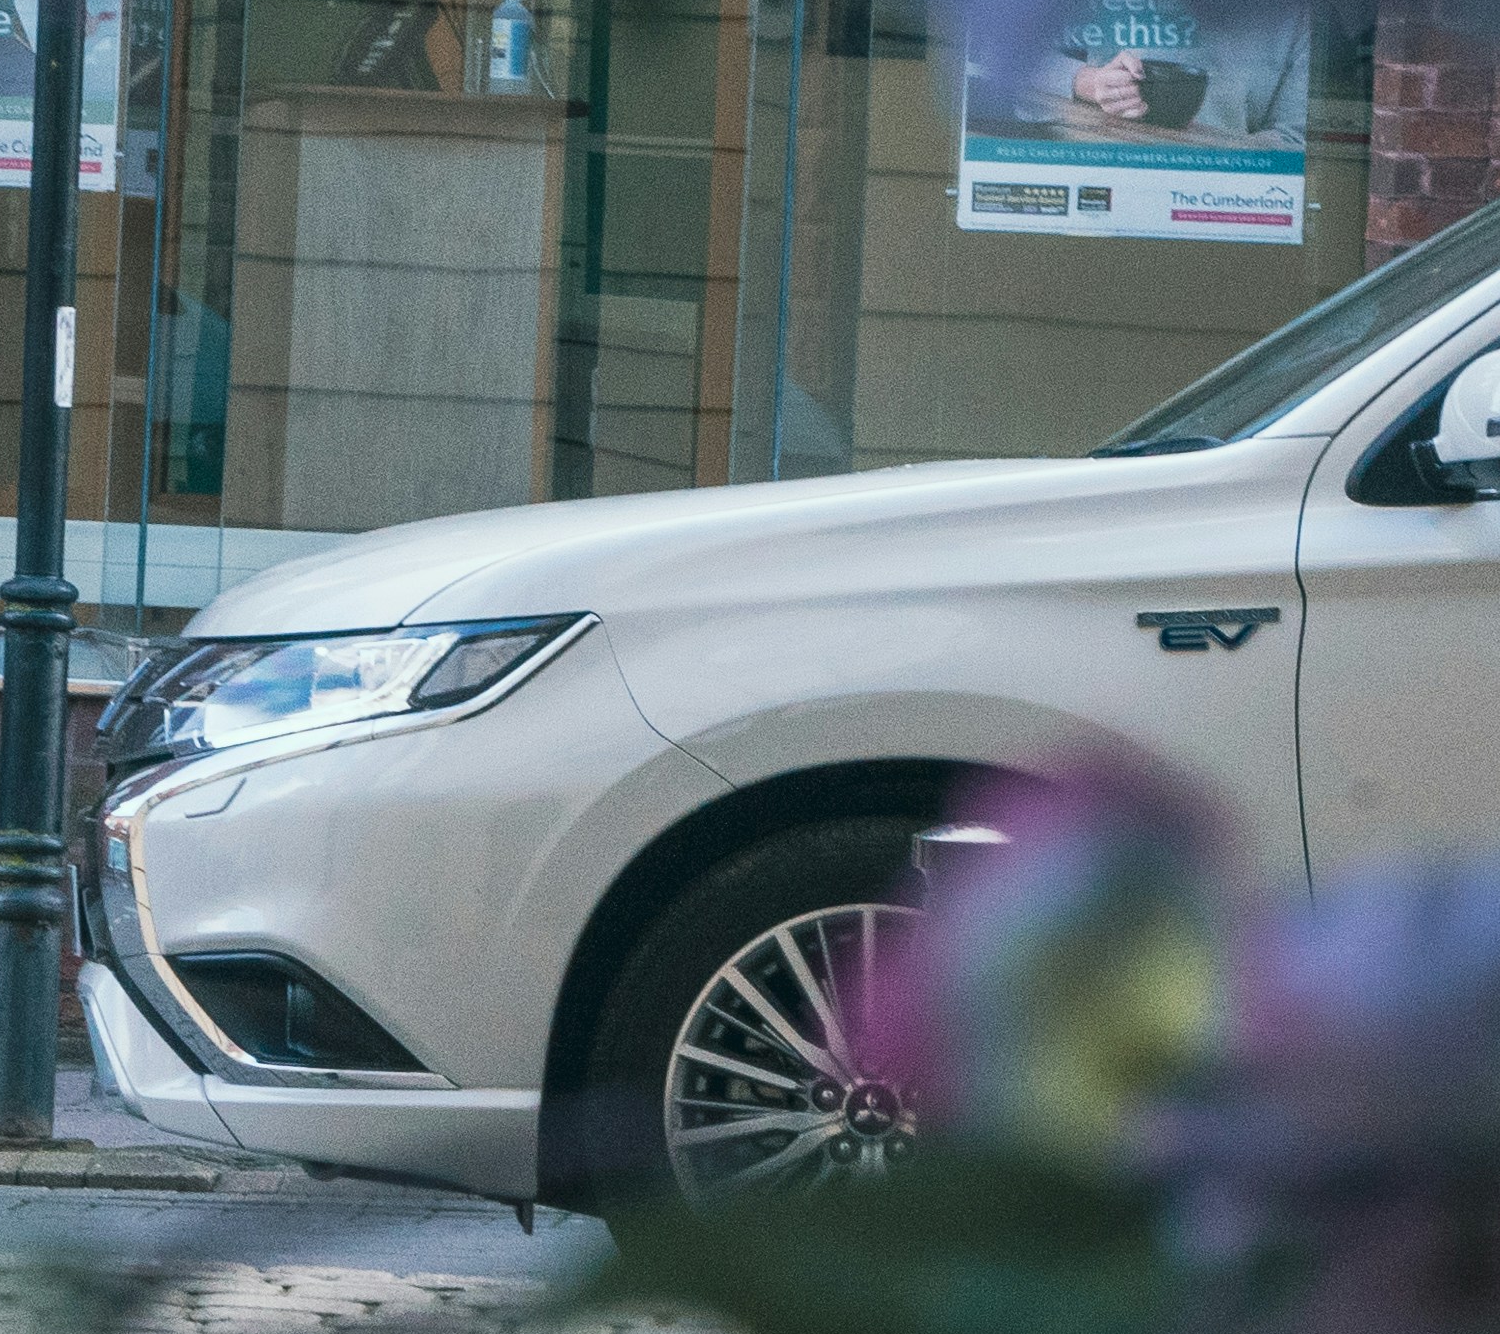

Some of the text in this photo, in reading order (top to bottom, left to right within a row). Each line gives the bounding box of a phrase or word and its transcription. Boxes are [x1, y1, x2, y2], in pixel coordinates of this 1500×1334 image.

[1171, 191, 1294, 211] The Cumberland
[1160, 623, 1261, 651] EV
